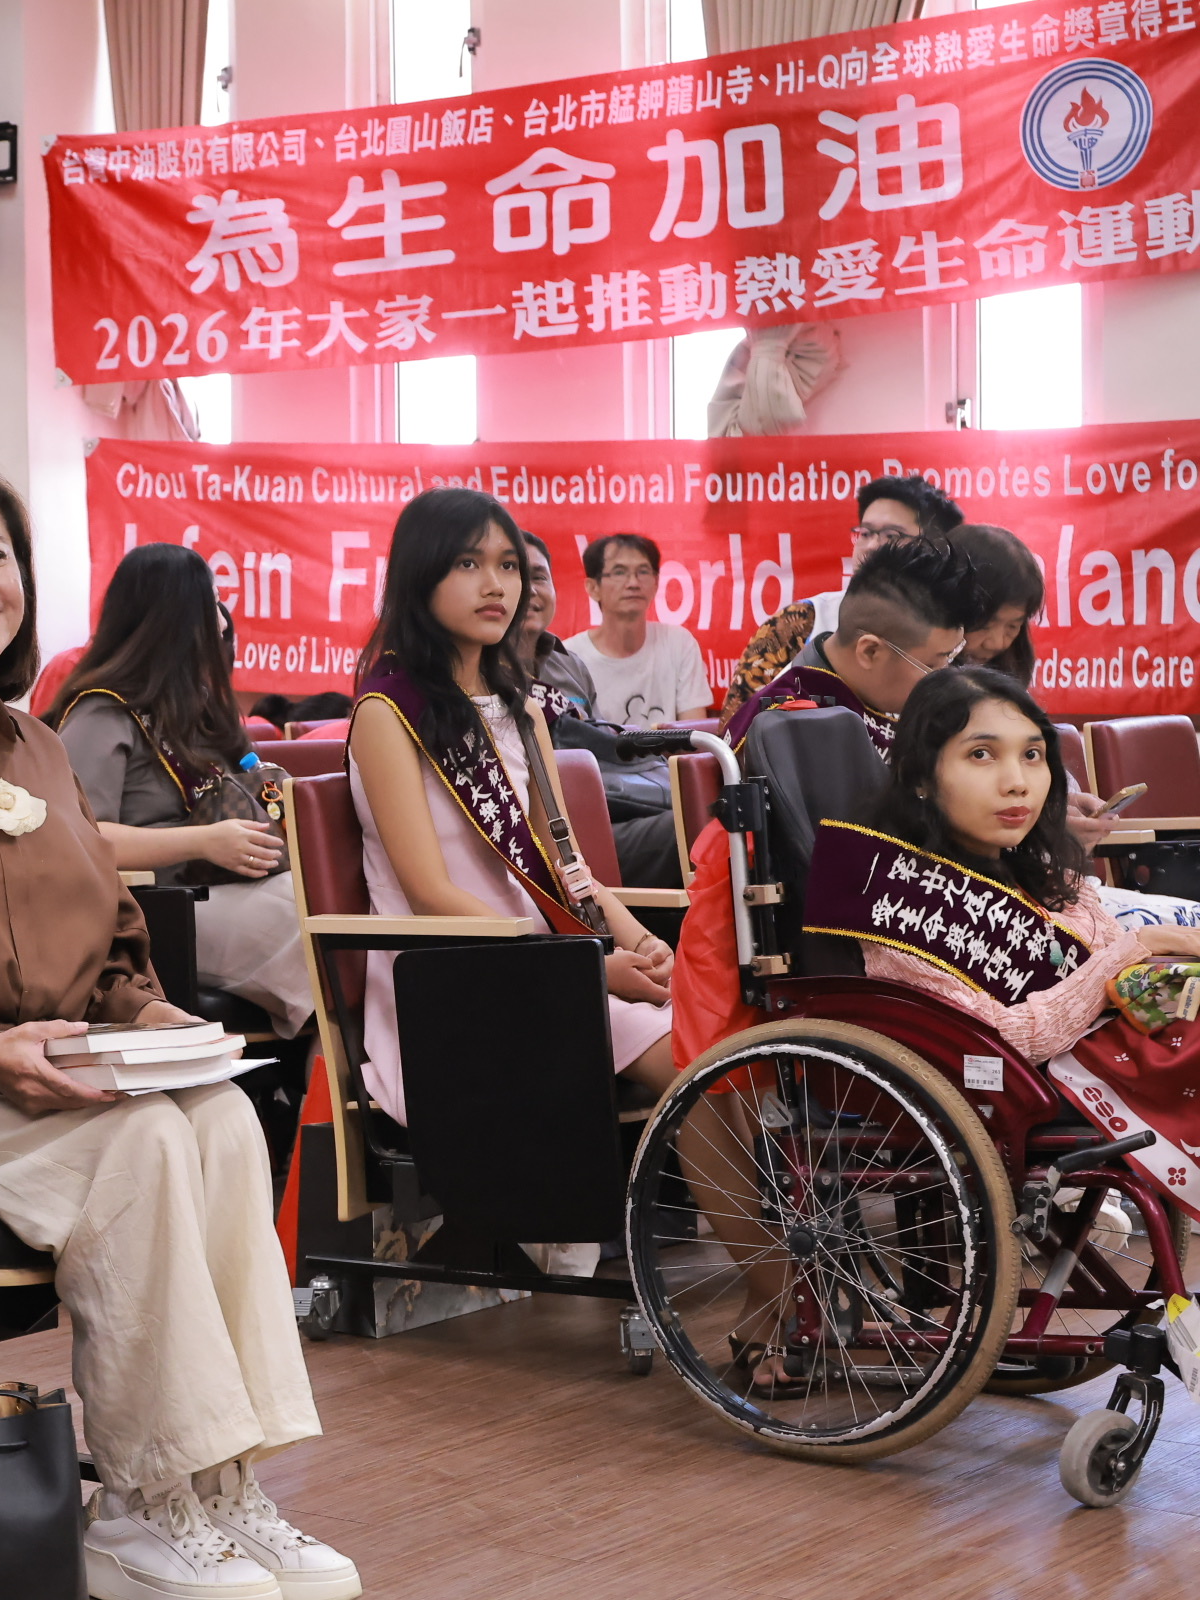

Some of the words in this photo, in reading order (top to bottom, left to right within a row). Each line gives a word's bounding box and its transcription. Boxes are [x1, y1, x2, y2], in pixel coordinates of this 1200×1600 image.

[186, 93, 964, 294] 為生命加油
[116, 462, 187, 499] Chou
[192, 465, 303, 503] Ta-Kuan
[311, 466, 422, 504] Cultural
[491, 464, 673, 505] Educational
[684, 460, 872, 503] Foundation
[1064, 454, 1151, 496] Love
[285, 637, 308, 673] of
[1132, 645, 1195, 688] Care
[872, 893, 1034, 1001] 愛生命獎章得主
